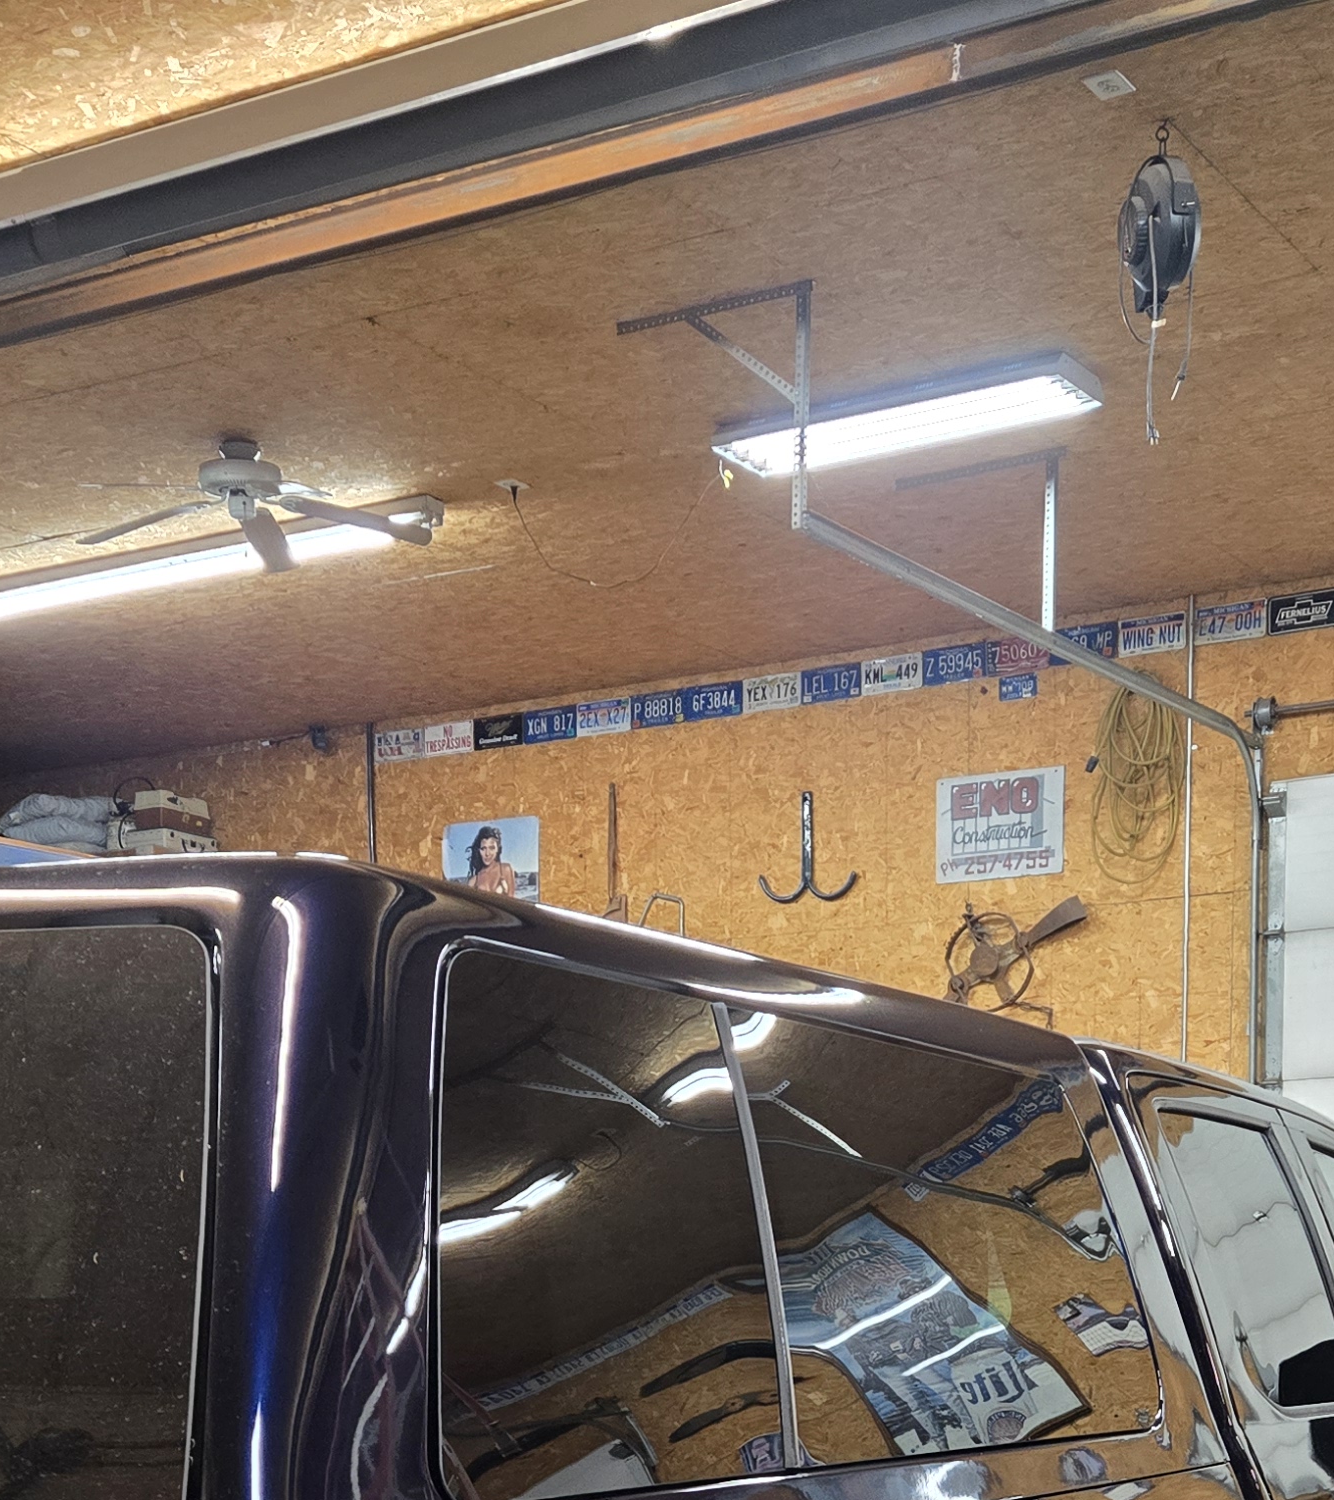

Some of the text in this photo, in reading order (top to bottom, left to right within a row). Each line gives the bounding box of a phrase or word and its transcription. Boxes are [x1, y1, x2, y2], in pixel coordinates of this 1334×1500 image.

[1280, 604, 1327, 620] FERNELIUS
[1121, 627, 1155, 652] WING
[1157, 623, 1184, 646] NUT
[864, 666, 887, 686] KML
[895, 662, 918, 680] 449
[938, 650, 983, 675] 59945
[747, 681, 798, 702] YEX 176
[804, 669, 858, 697] LEL 167
[443, 724, 454, 738] NO
[527, 713, 575, 736] XGN 817
[425, 735, 472, 754] TRESPASSING
[951, 776, 1040, 822] ENO
[952, 820, 1048, 845] Construction
